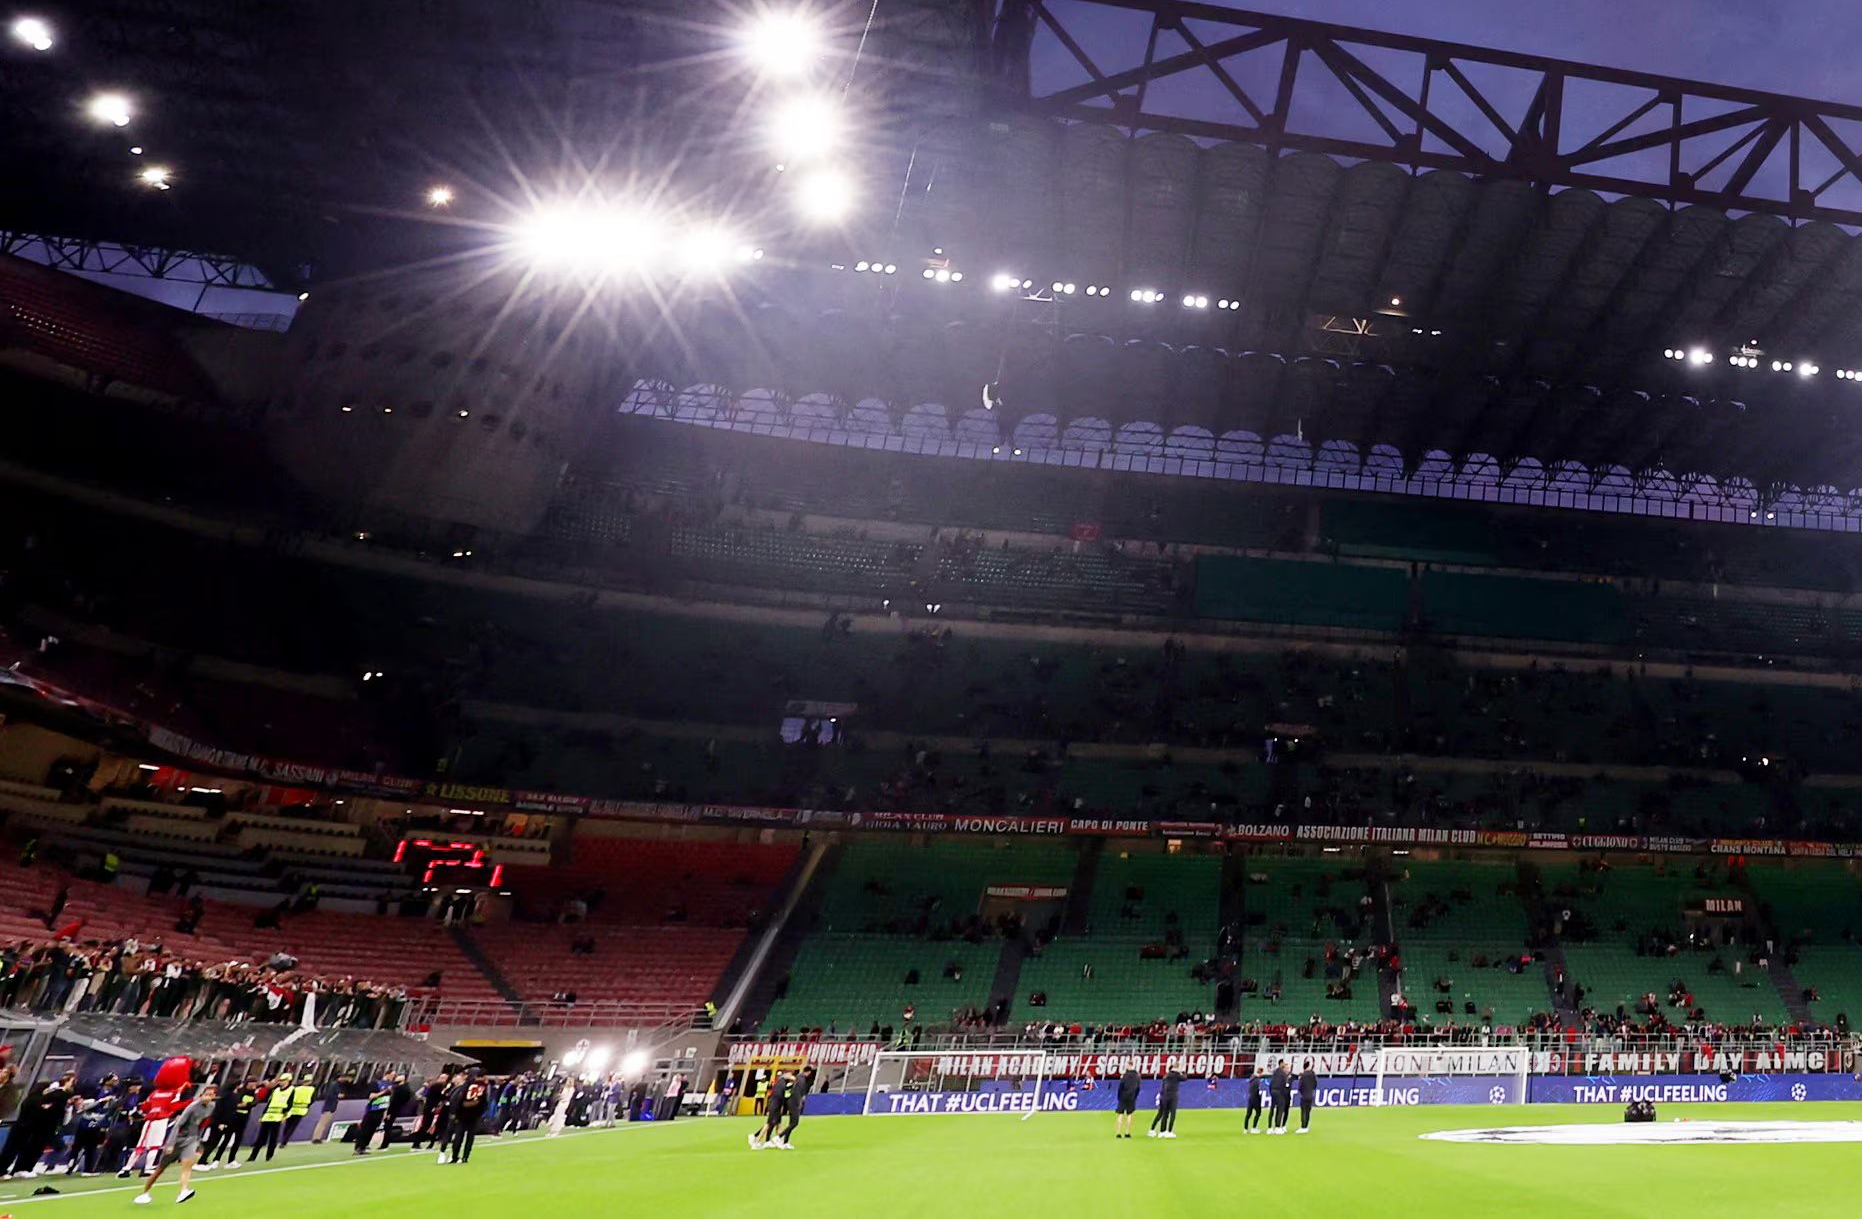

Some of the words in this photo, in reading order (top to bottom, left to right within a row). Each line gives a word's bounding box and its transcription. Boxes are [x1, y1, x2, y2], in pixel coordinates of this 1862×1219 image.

[439, 784, 511, 804] LISSONE
[954, 818, 1065, 834] MONCALIERI
[1070, 819, 1099, 830] CAPO
[1101, 820, 1113, 830] DI
[1116, 820, 1149, 831] PONTE
[1238, 824, 1290, 837] BOLZANO
[1296, 824, 1369, 841] ASSOCIAZIONE
[1372, 826, 1416, 842] ITALIANA
[1418, 827, 1449, 843] MILAN
[1583, 835, 1628, 848] CUGGIONO
[1711, 845, 1742, 855] CRANS
[1743, 845, 1787, 855] MONTANA
[1705, 899, 1742, 912] MILAN
[936, 1054, 991, 1075] MILAN
[997, 1054, 1078, 1076] ACADEMY
[1095, 1054, 1159, 1075] SCUOLA
[1165, 1054, 1227, 1075] CALCIO
[1449, 1053, 1518, 1072] MILAN
[1583, 1053, 1681, 1072] FAMILY
[1693, 1052, 1744, 1071] DAY
[888, 1094, 943, 1113] THAT
[945, 1091, 1078, 1112] #UCLFEELING
[1314, 1088, 1420, 1107] UCLFEELING
[1573, 1085, 1617, 1103] THAT
[1620, 1084, 1728, 1102] #UCLFEELING
